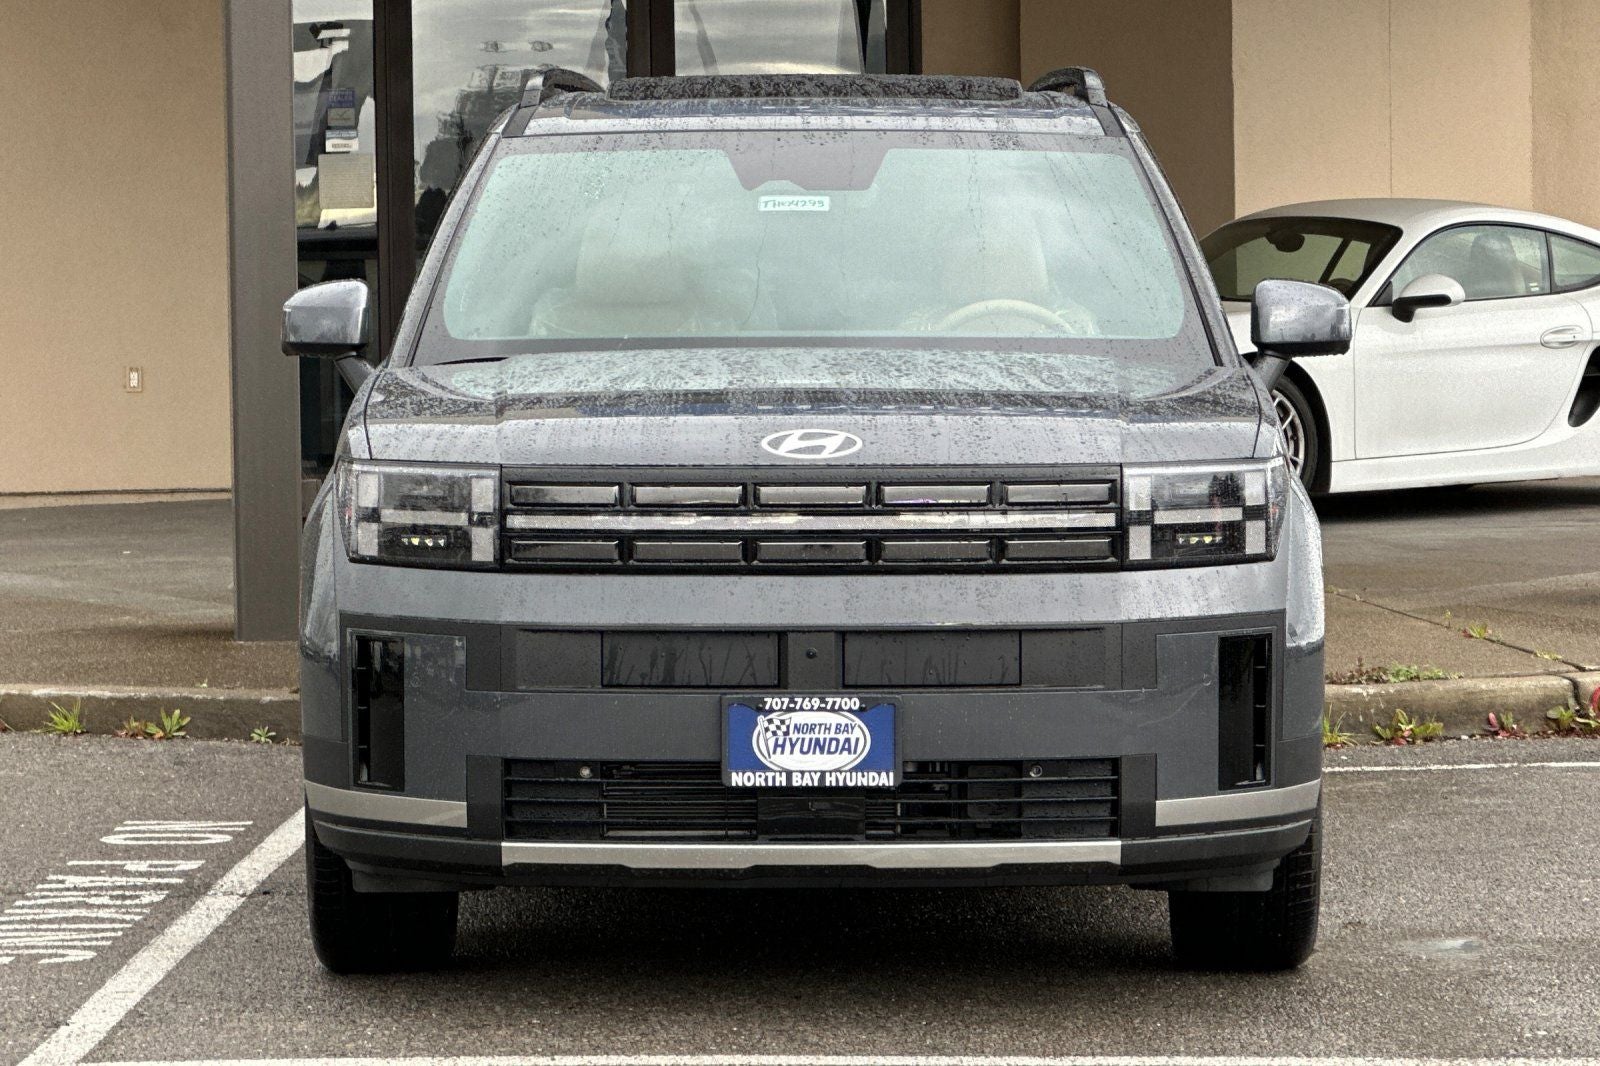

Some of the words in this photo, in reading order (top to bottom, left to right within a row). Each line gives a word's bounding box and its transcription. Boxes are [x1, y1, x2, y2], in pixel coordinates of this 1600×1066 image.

[763, 697, 860, 711] 707-769-7700
[792, 722, 833, 735] NORTH
[834, 722, 857, 735] BAY
[772, 737, 860, 755] HYUNDAI
[731, 772, 787, 787] NORTH
[791, 772, 821, 787] BAY
[825, 772, 894, 787] HYUNDAI
